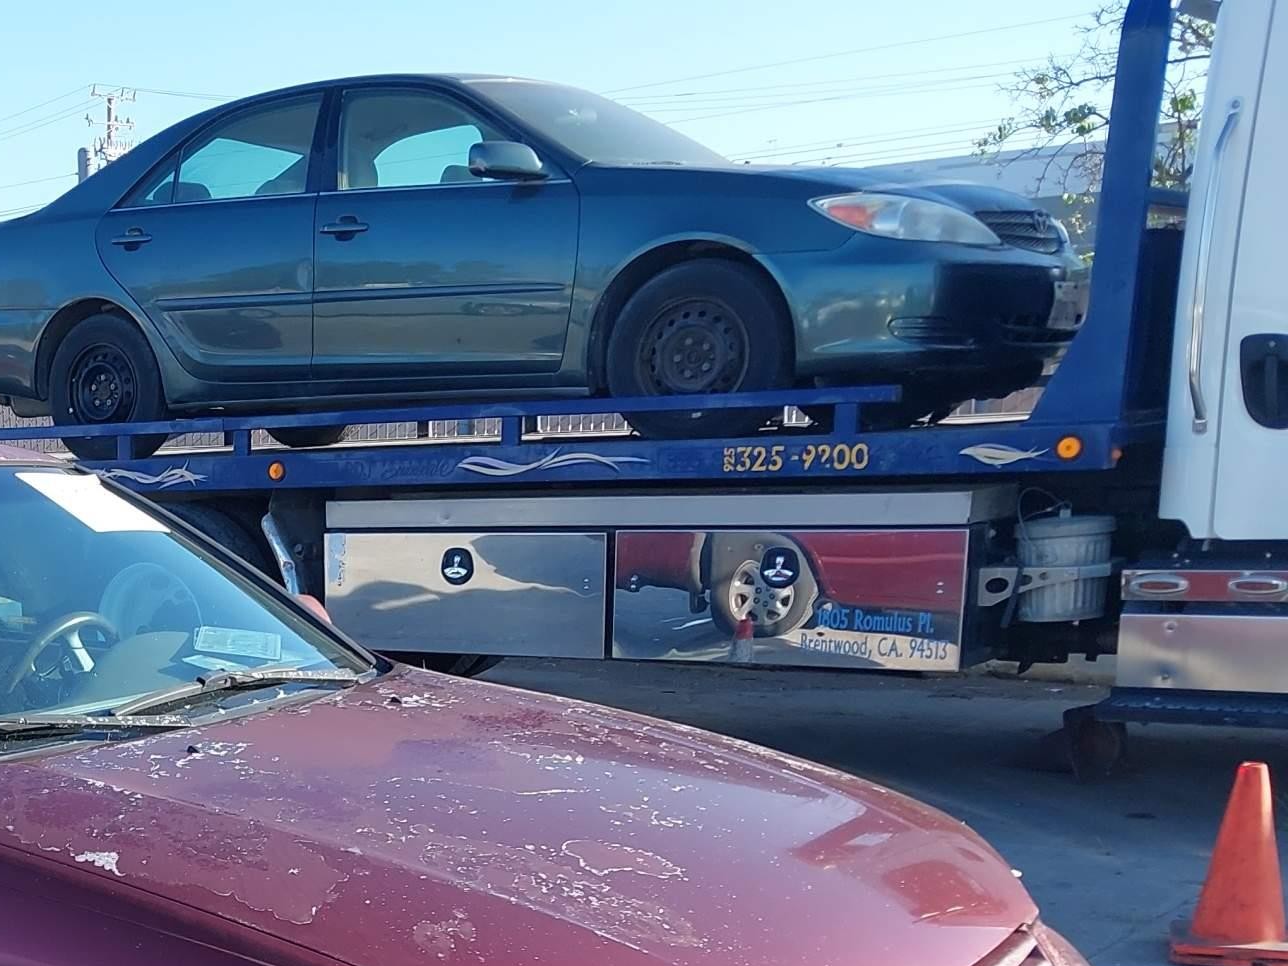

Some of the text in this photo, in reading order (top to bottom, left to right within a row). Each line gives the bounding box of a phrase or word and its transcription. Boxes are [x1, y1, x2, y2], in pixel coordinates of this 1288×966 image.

[723, 447, 736, 472] 925
[818, 608, 934, 634] 1805 Romulus Pl.
[800, 632, 948, 660] Brentwood, CA. 94513
